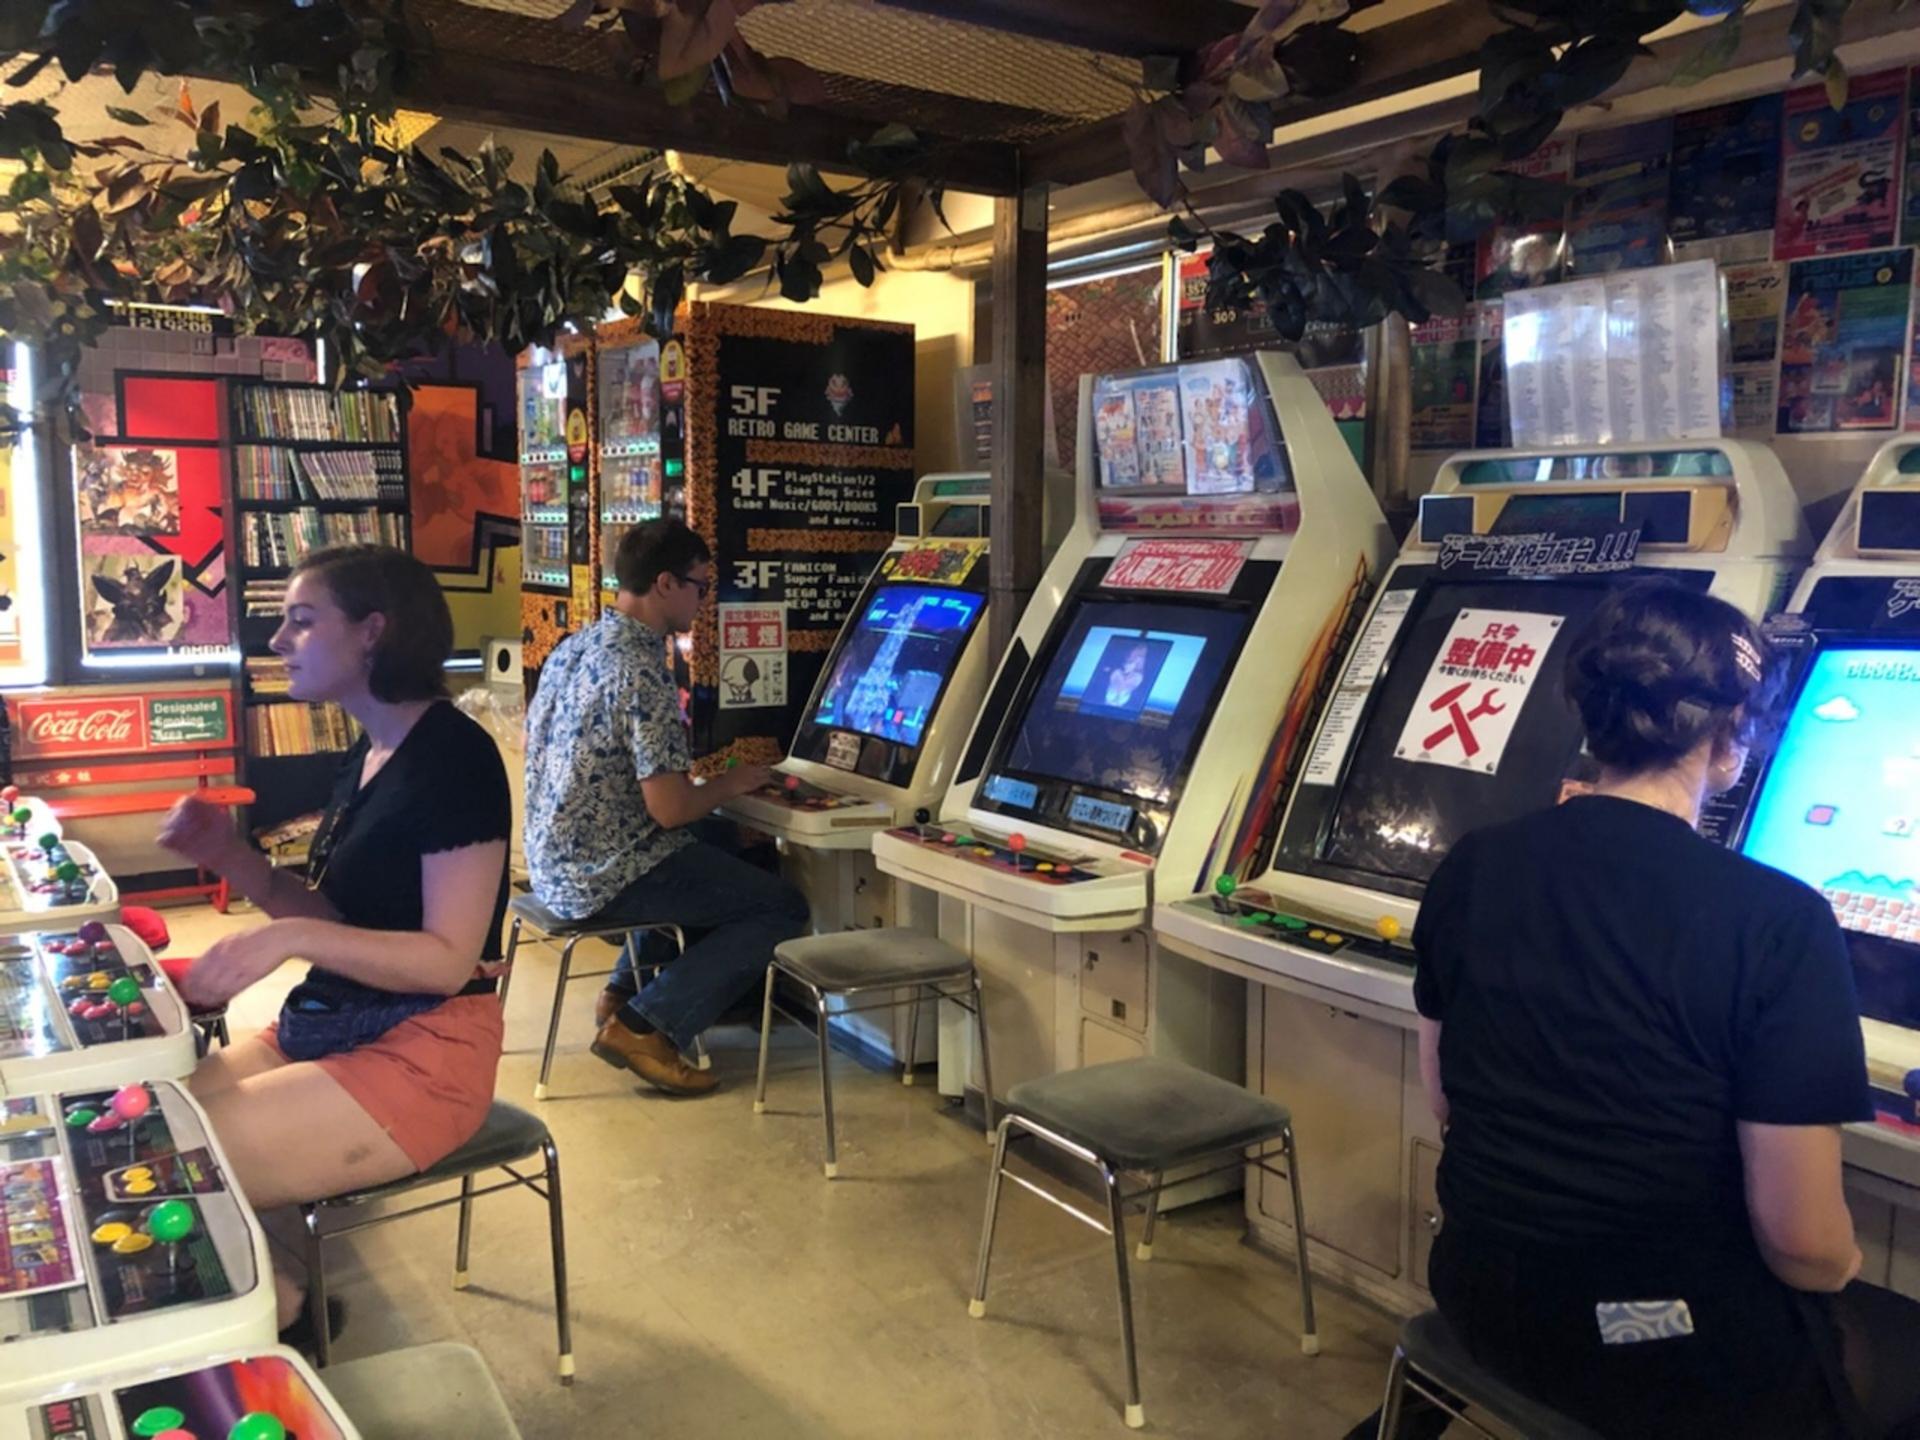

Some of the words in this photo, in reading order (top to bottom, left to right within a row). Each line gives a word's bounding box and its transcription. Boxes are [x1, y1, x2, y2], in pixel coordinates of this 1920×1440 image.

[730, 385, 781, 416] 5F
[728, 418, 776, 437] RETRO
[783, 421, 820, 441] GAME
[827, 425, 880, 444] CENTER
[731, 468, 782, 497] 4F
[733, 560, 782, 588] 3F
[784, 587, 818, 599] SEGA
[1442, 637, 1537, 673] 整備中
[153, 700, 218, 715] Designated
[27, 708, 137, 744] Coca-Cola
